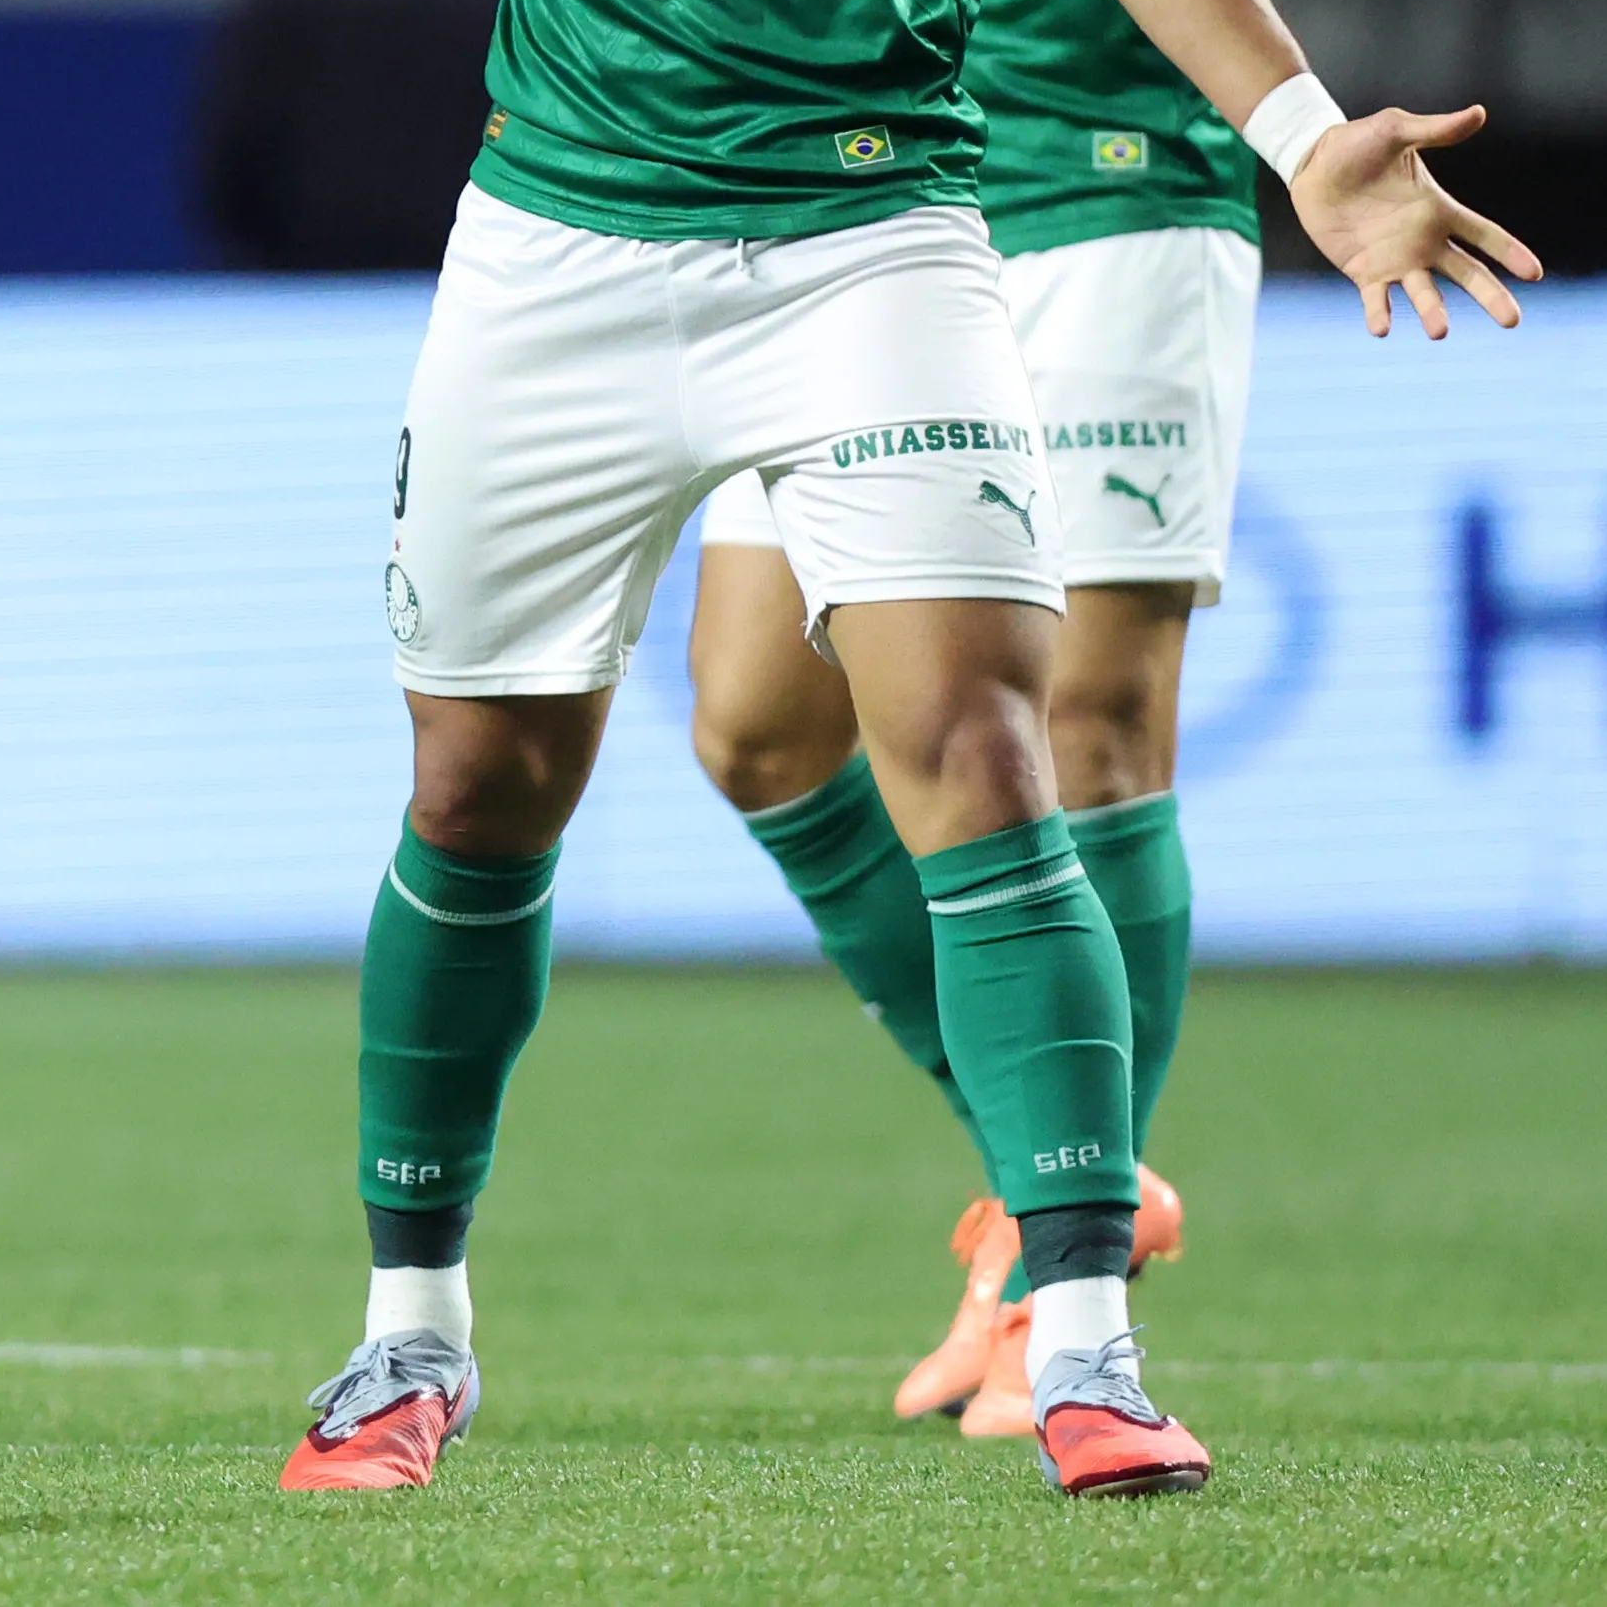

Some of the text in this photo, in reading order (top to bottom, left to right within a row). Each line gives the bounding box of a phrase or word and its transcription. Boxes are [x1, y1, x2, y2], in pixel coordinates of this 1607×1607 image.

[831, 422, 1033, 470] UNIASSELVI
[394, 426, 411, 520] 9
[377, 1158, 441, 1185] SEP
[1034, 1143, 1101, 1173] SEP
